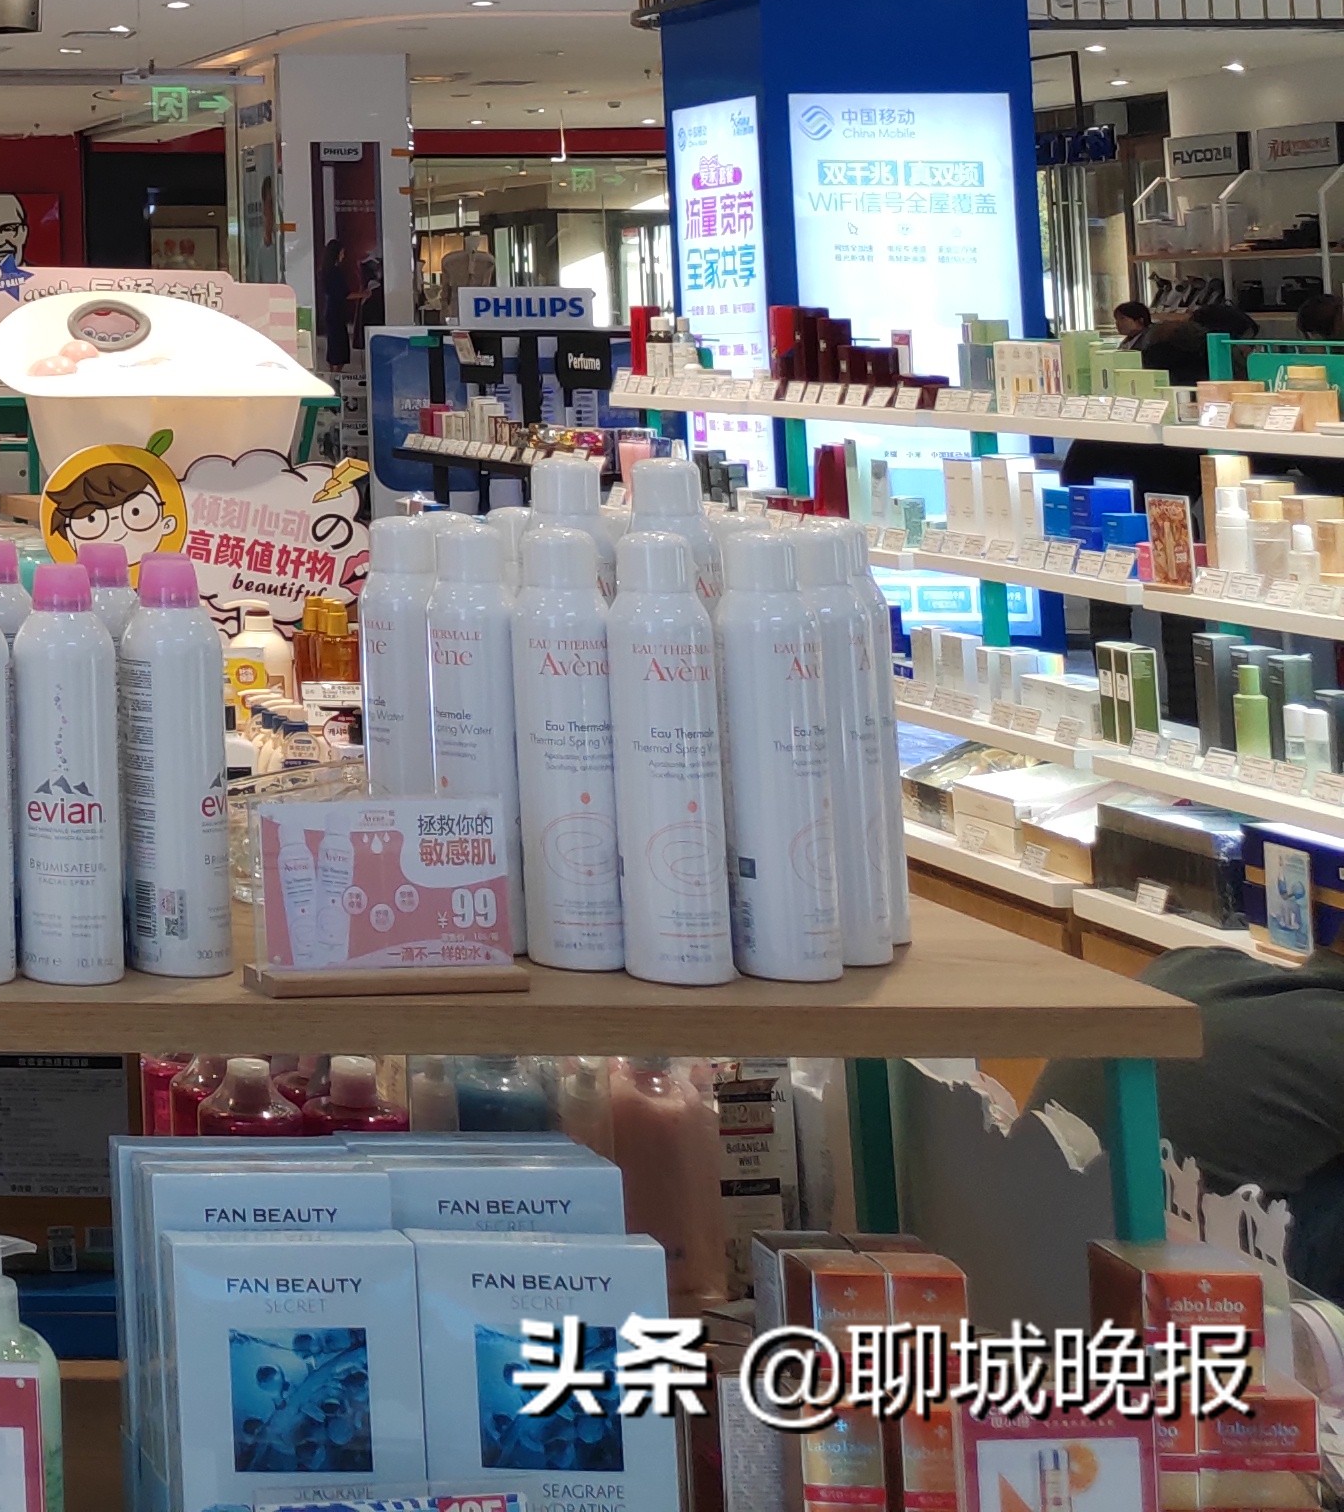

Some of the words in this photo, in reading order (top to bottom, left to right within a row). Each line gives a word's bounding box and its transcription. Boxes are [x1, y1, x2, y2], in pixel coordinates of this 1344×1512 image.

[841, 108, 915, 126] 中国移动
[843, 128, 875, 139] China
[879, 128, 916, 139] Mobile
[324, 147, 359, 156] PHILIPS
[808, 192, 997, 215] WiFi信号全屋覆盖
[473, 297, 584, 318] PHILIPS
[568, 353, 601, 370] Perfume
[312, 514, 353, 550] の
[186, 529, 336, 586] 高颜值好物
[545, 721, 565, 732] Eau
[651, 728, 671, 739] Eau
[418, 814, 493, 836] 拯救你的
[419, 838, 496, 867] 敏感肌
[205, 1208, 247, 1225] FAN
[253, 1208, 338, 1225] BEAUTY
[437, 1199, 483, 1215] FAN
[487, 1199, 572, 1216] BEAUTY
[226, 1277, 270, 1294] FAN
[276, 1277, 362, 1294] BEAUTY
[471, 1273, 515, 1290] FAN
[520, 1273, 612, 1293] BEAUTY
[264, 1297, 327, 1314] SECRET
[511, 1294, 574, 1312] SECRET
[542, 1482, 625, 1500] SEAGRAPE
